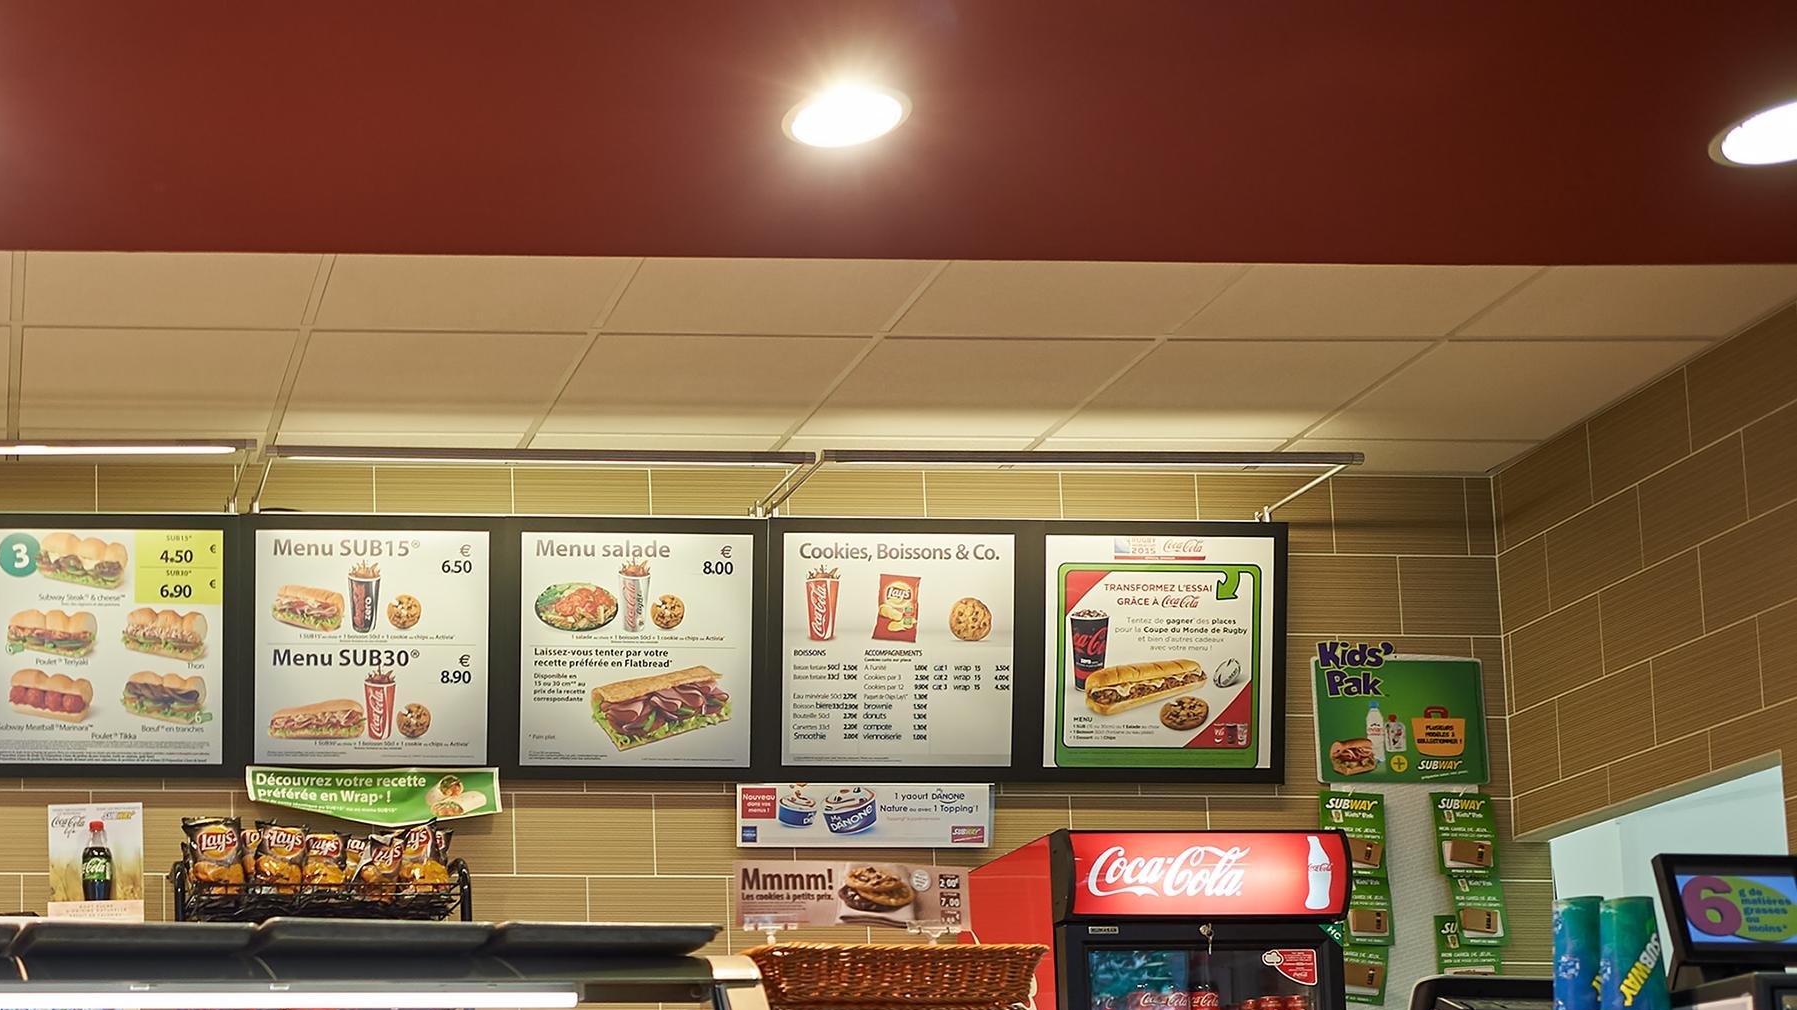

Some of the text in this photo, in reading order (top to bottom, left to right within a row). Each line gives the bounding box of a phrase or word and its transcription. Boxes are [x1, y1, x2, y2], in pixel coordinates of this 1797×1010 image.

[273, 539, 333, 556] Menu
[460, 544, 471, 556] €
[536, 540, 670, 557] Menu salade
[721, 545, 732, 558] €
[799, 543, 999, 561] Cookies, Boissons & Co.
[13, 543, 29, 568] 3
[160, 550, 193, 563] 4.50
[442, 560, 472, 573] 6.50
[703, 562, 733, 575] 8.00
[160, 585, 191, 598] 6.90
[1104, 583, 1212, 592] TRANSFORMEZ L'ESSAI
[1117, 596, 1150, 606] GRÂCE
[1152, 596, 1158, 606] À
[1166, 618, 1193, 626] gagner
[1212, 617, 1236, 626] places
[1144, 627, 1169, 635] Coupe
[1223, 627, 1247, 636] Rugby
[273, 649, 333, 666] Menu
[535, 648, 669, 658] Laissez-vous tenter par votre
[459, 654, 470, 667] €
[534, 659, 567, 667] recette
[569, 659, 609, 668] préférée
[441, 671, 471, 684] 8.90
[1325, 670, 1383, 698] Pak
[1418, 761, 1463, 769] SUBWAY
[256, 773, 426, 787] Découvrez votre recette
[259, 788, 317, 802] préférée
[321, 792, 337, 801] en
[902, 793, 928, 802] yaourt
[1326, 798, 1378, 810] SUBWAY
[1438, 798, 1485, 810] SUBWAY
[741, 868, 833, 891] Mmmm!
[757, 893, 783, 901] cookies
[793, 892, 813, 902] petits
[1682, 876, 1742, 936] 6
[1327, 927, 1342, 940] HC
